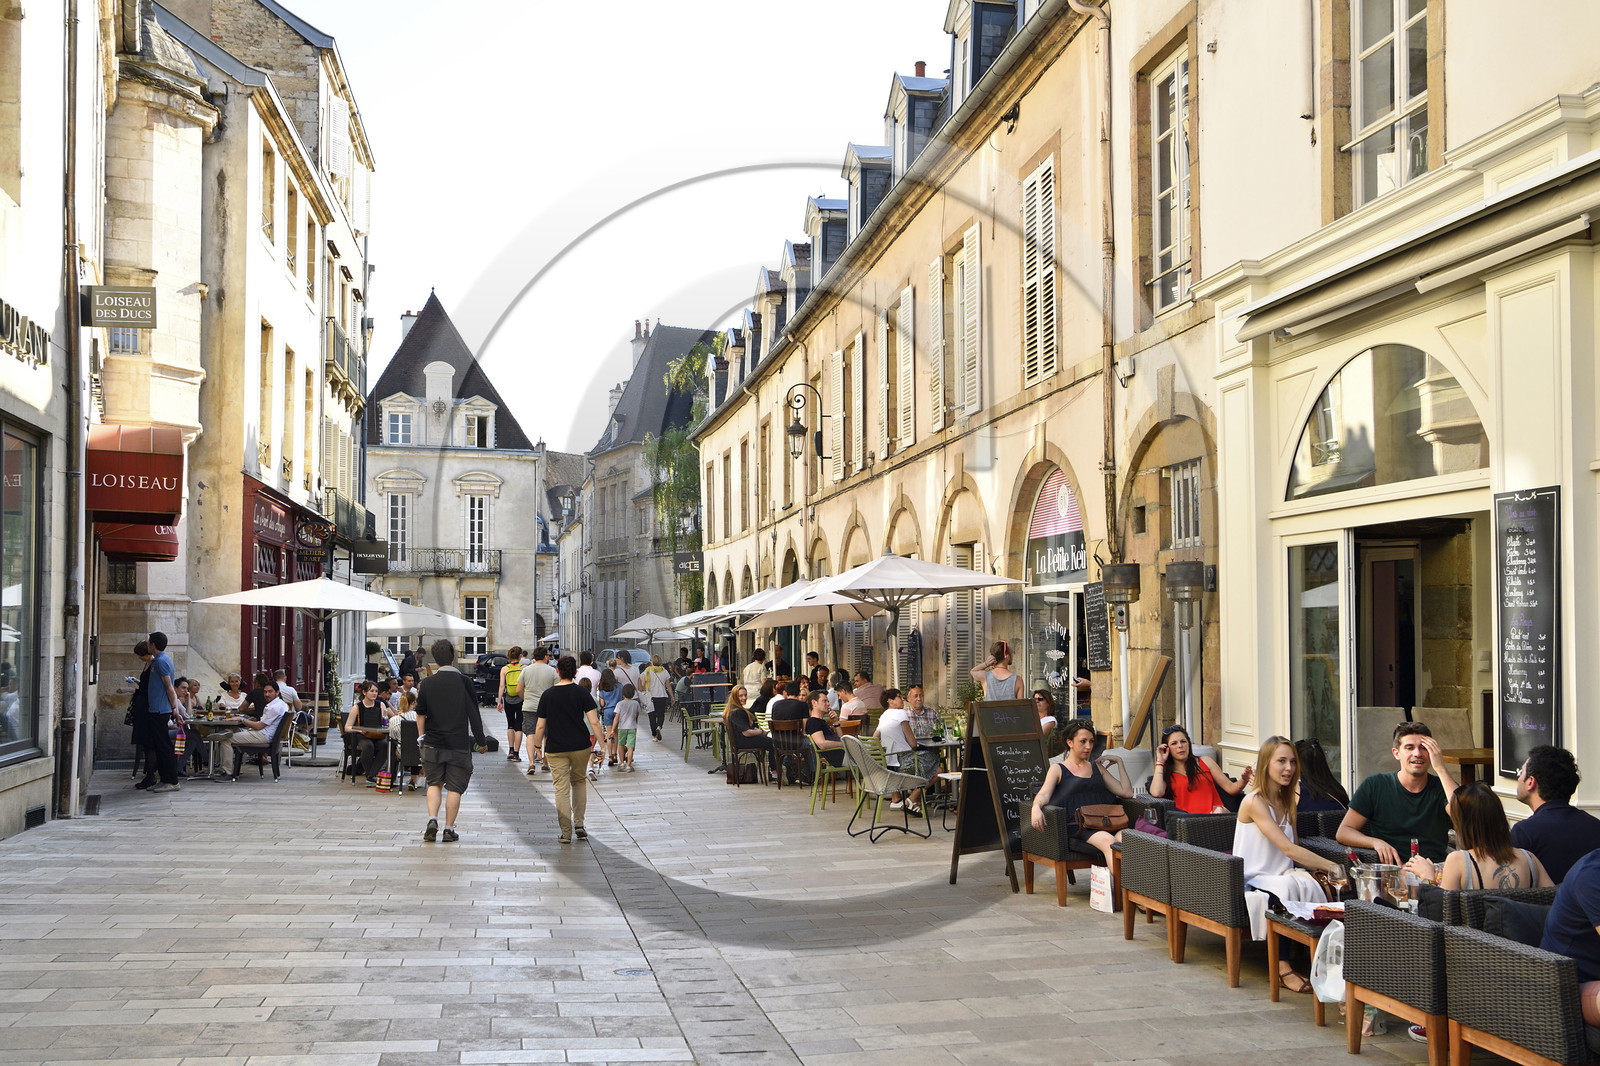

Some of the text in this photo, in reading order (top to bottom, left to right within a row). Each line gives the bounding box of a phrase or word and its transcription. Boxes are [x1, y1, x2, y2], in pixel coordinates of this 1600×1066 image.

[95, 295, 151, 307] LOISEAU
[95, 308, 152, 319] DES DUCS
[91, 473, 178, 491] LOISEAU
[1036, 549, 1047, 575] La
[1047, 546, 1070, 574] Petite
[1207, 567, 1214, 589] 2
